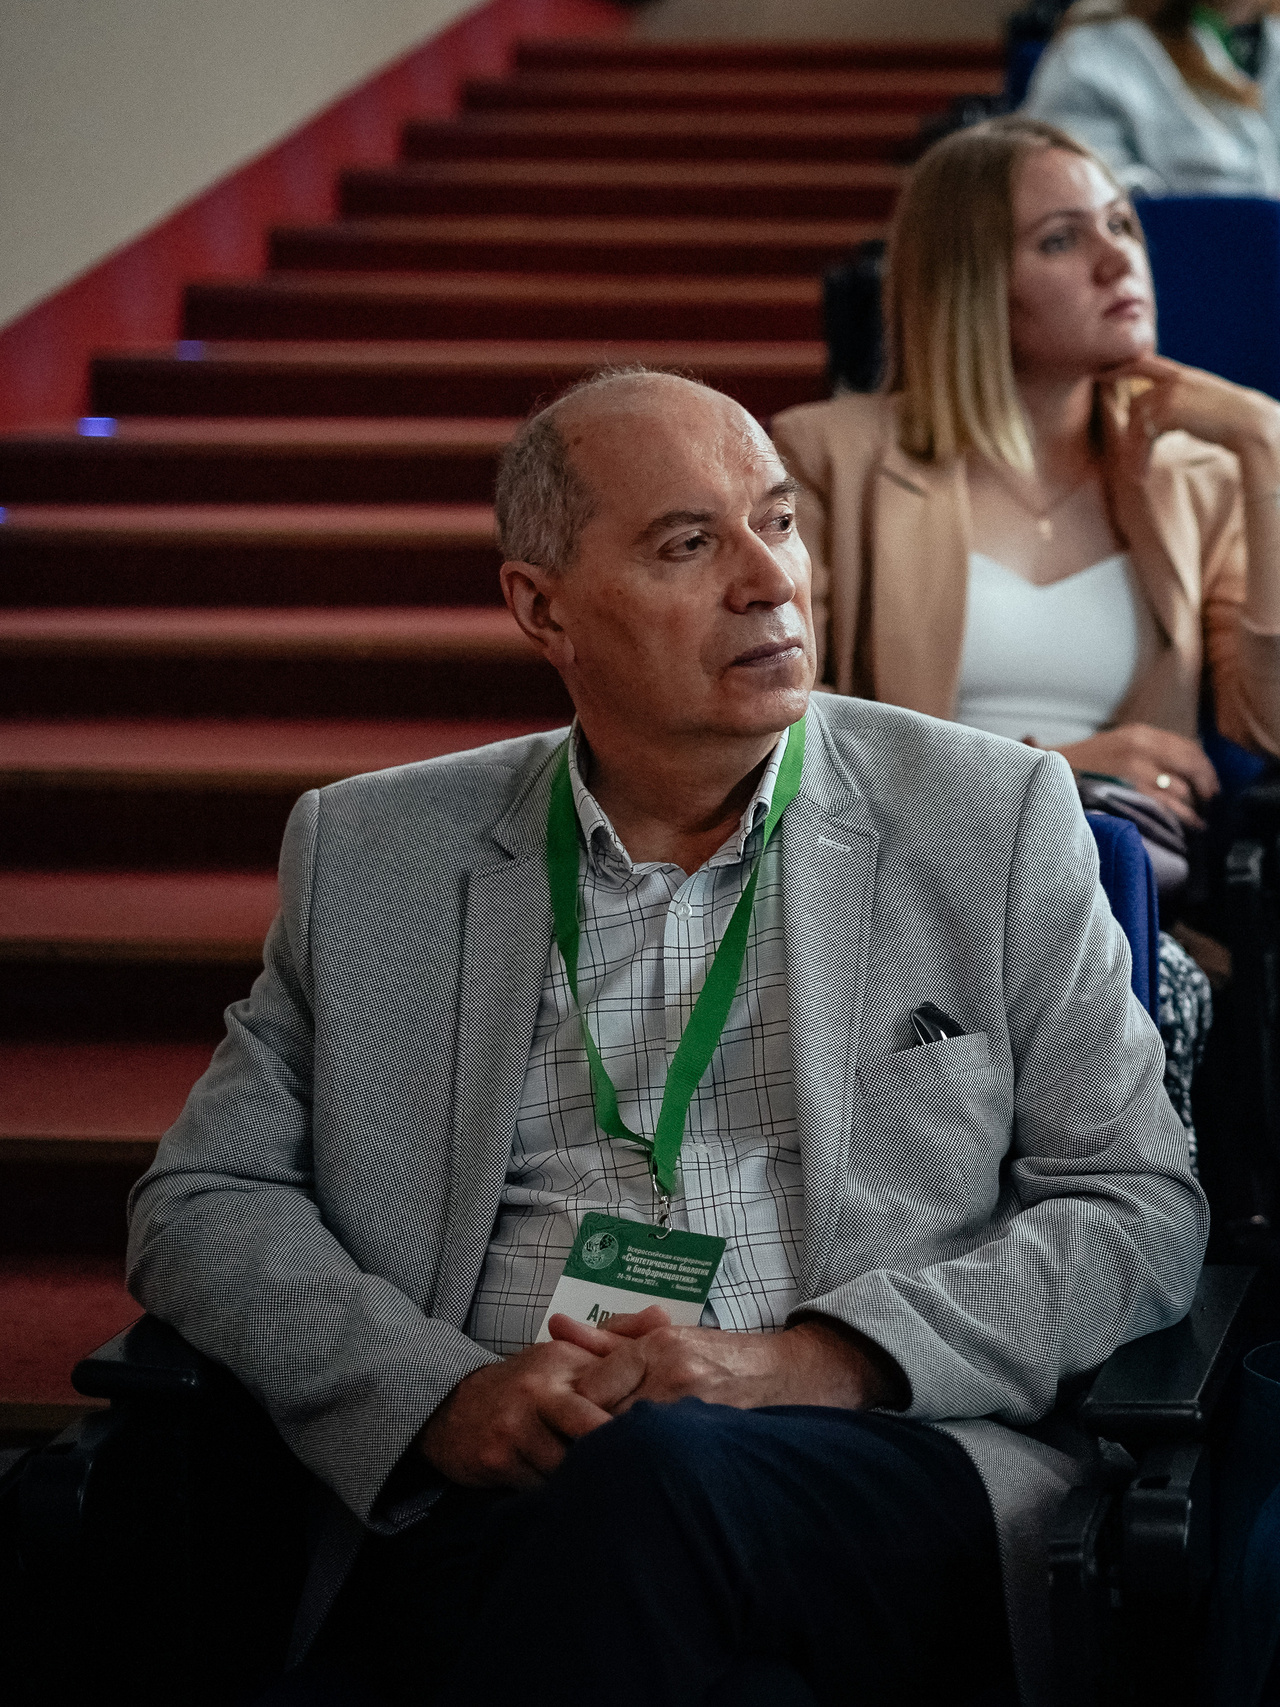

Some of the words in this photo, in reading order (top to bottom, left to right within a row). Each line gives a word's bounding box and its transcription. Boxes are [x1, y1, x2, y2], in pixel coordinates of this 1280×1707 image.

[622, 1252, 678, 1270] «Синтетическая
[678, 1264, 710, 1276] биология
[627, 1245, 672, 1260] Всероссийская
[672, 1257, 712, 1266] конференция
[632, 1264, 698, 1284] биофармацевтика»
